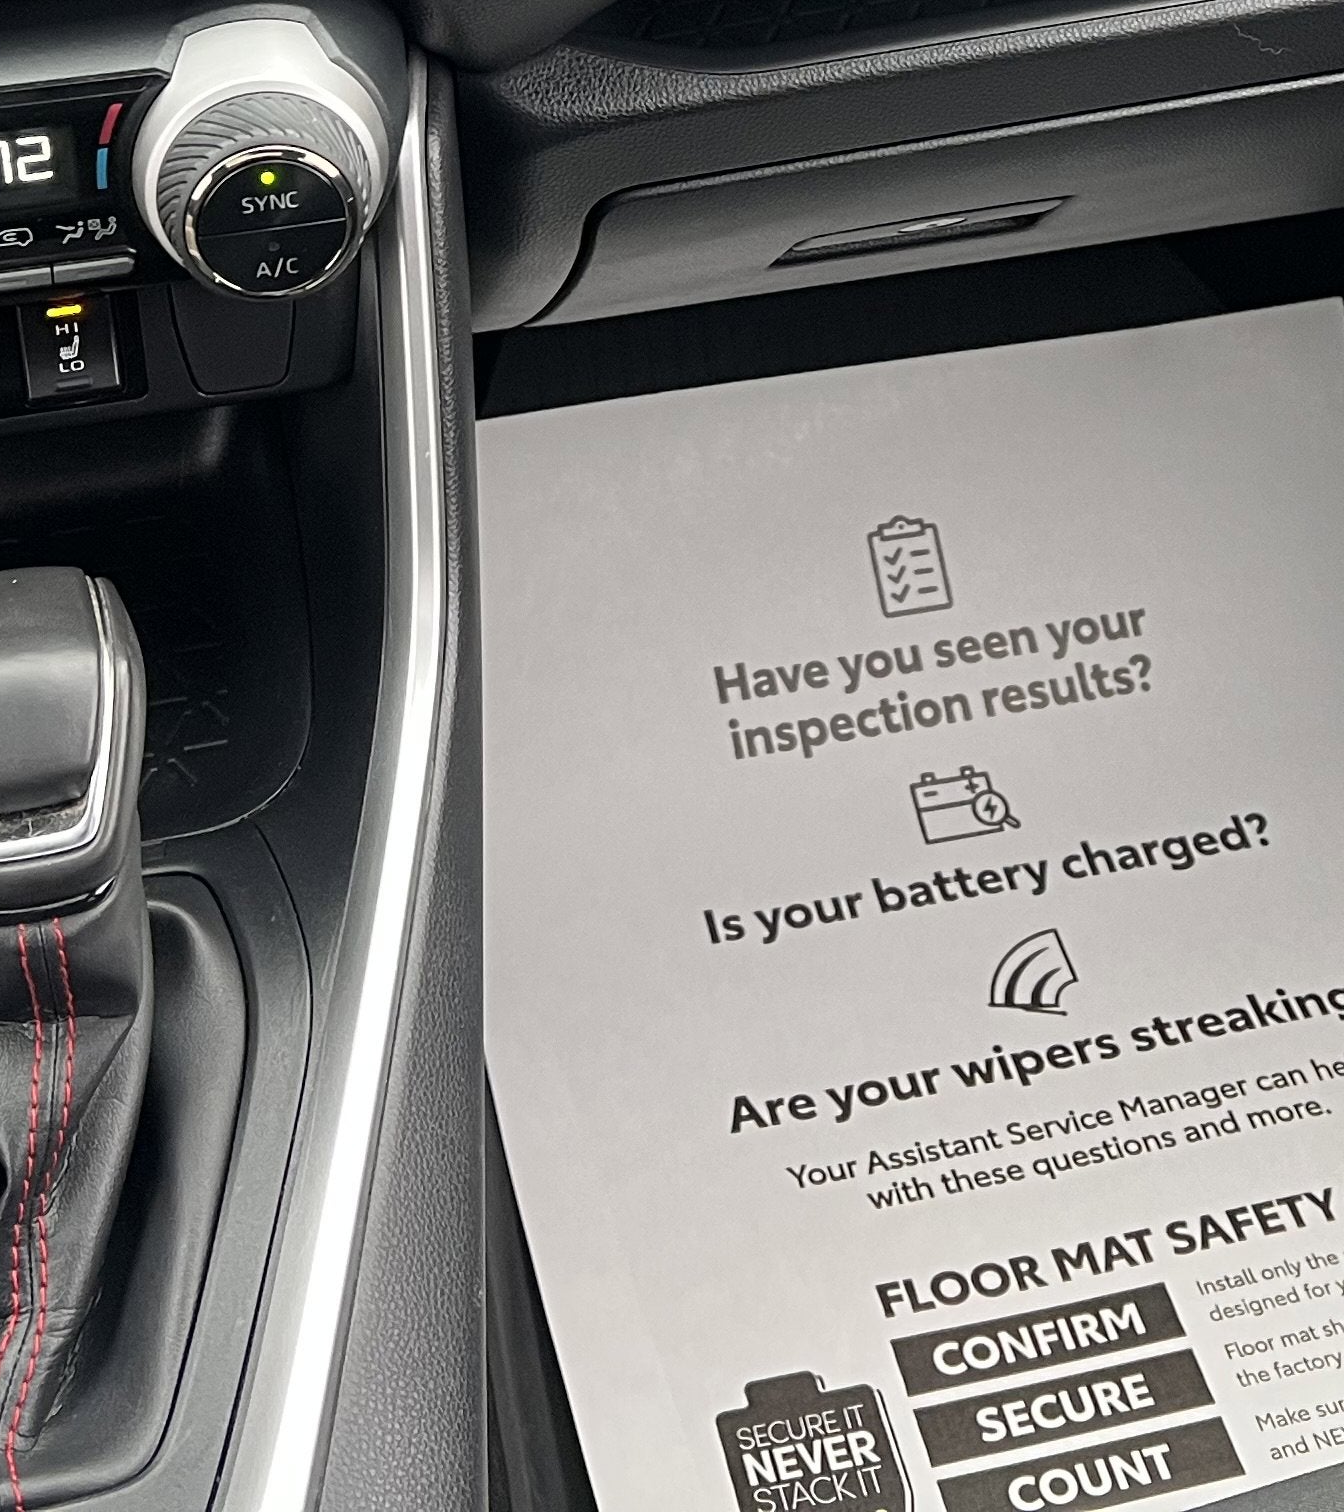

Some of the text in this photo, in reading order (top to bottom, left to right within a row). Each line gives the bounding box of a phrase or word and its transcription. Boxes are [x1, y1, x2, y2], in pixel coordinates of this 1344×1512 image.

[241, 191, 299, 214] SYNC
[256, 256, 299, 278] A/C
[56, 323, 79, 336] HI
[60, 359, 85, 374] LO
[713, 606, 1147, 705] Have you seen your
[728, 653, 1154, 760] inspection results?
[704, 811, 1272, 945] Is your battery charged?
[729, 1090, 818, 1133] Are
[824, 1060, 942, 1123] your
[951, 1032, 1121, 1089] wipers
[786, 1155, 858, 1191] Your
[867, 1126, 1003, 1177] Assistant
[1006, 1103, 1114, 1147] Service
[1117, 1076, 1249, 1129] Manager
[1256, 1061, 1307, 1091] can
[866, 1095, 1332, 1211] with these questions and more.
[875, 1254, 1047, 1318] FLOOR
[1051, 1228, 1155, 1282] MAT
[1165, 1186, 1338, 1256] SAFETY
[1195, 1267, 1258, 1297] Install
[1261, 1254, 1303, 1283] only
[1305, 1248, 1340, 1271] the
[1208, 1291, 1300, 1323] designed
[1303, 1276, 1332, 1301] for
[931, 1301, 1147, 1376] CONFIRM
[1224, 1334, 1275, 1361] Floor
[1280, 1326, 1320, 1347] mat
[1236, 1364, 1271, 1389] the
[1273, 1352, 1343, 1384] factory
[736, 1404, 864, 1450] SECURE IT
[975, 1371, 1155, 1443] SECURE
[1255, 1404, 1311, 1433] Make
[741, 1430, 881, 1486] NEVER
[1269, 1436, 1309, 1462] and
[753, 1465, 882, 1512] STACK IT
[1006, 1442, 1172, 1512] COUNT
